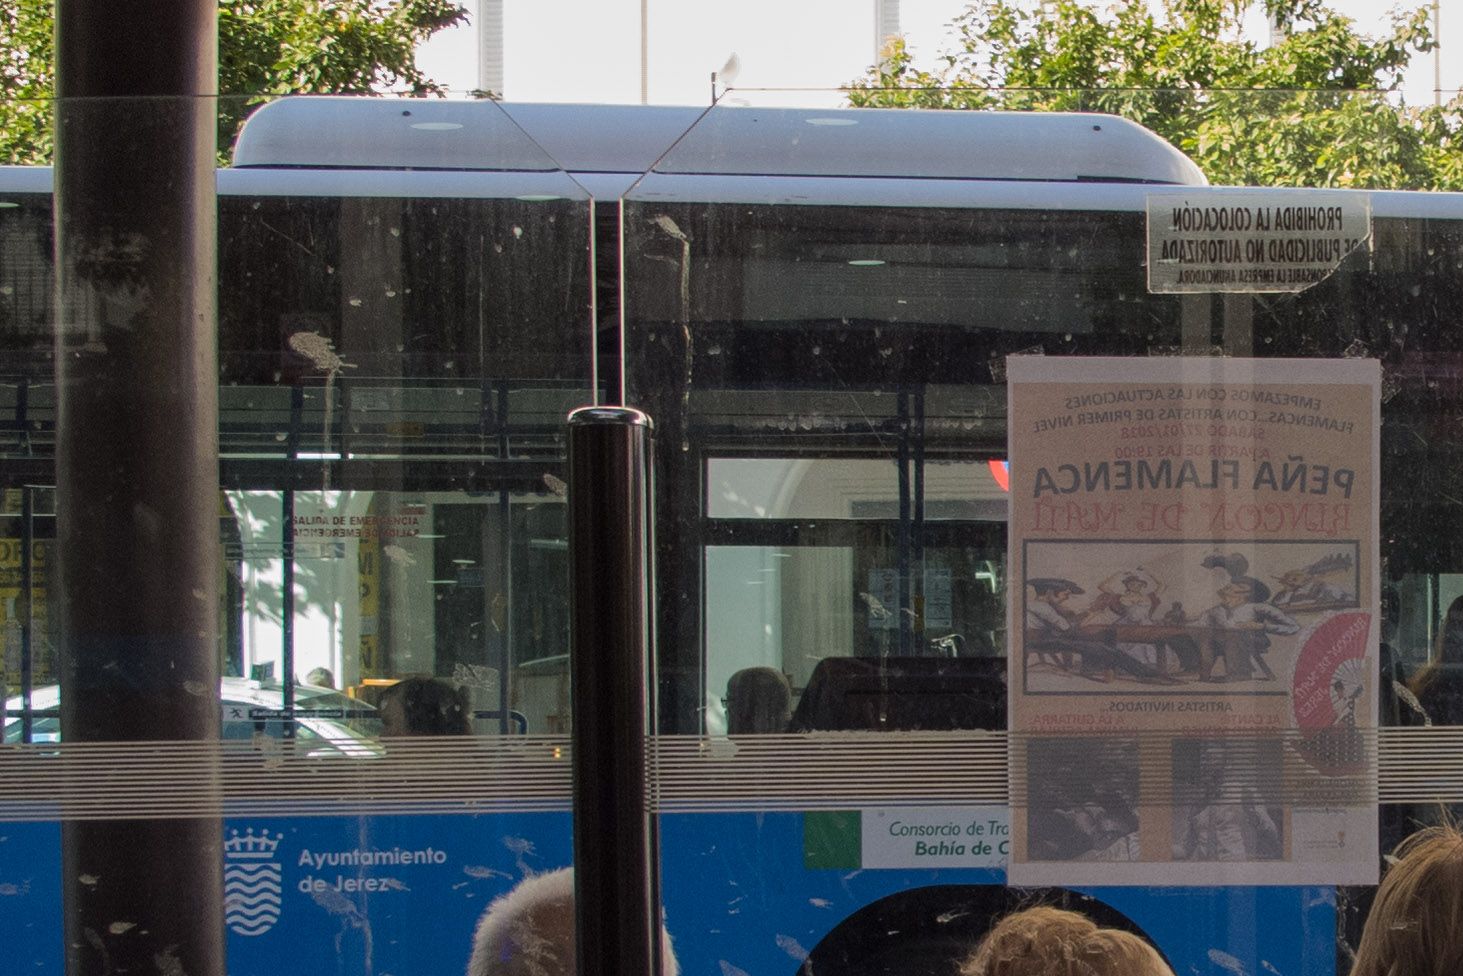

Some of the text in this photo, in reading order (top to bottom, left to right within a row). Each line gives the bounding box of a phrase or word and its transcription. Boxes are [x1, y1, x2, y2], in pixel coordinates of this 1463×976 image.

[333, 515, 346, 525] DE
[889, 820, 961, 837] Consorcio
[966, 820, 985, 836] de
[915, 840, 965, 856] Bahía
[971, 840, 992, 855] de
[298, 847, 447, 871] Ayuntamiento
[298, 874, 389, 893] de Jerez
